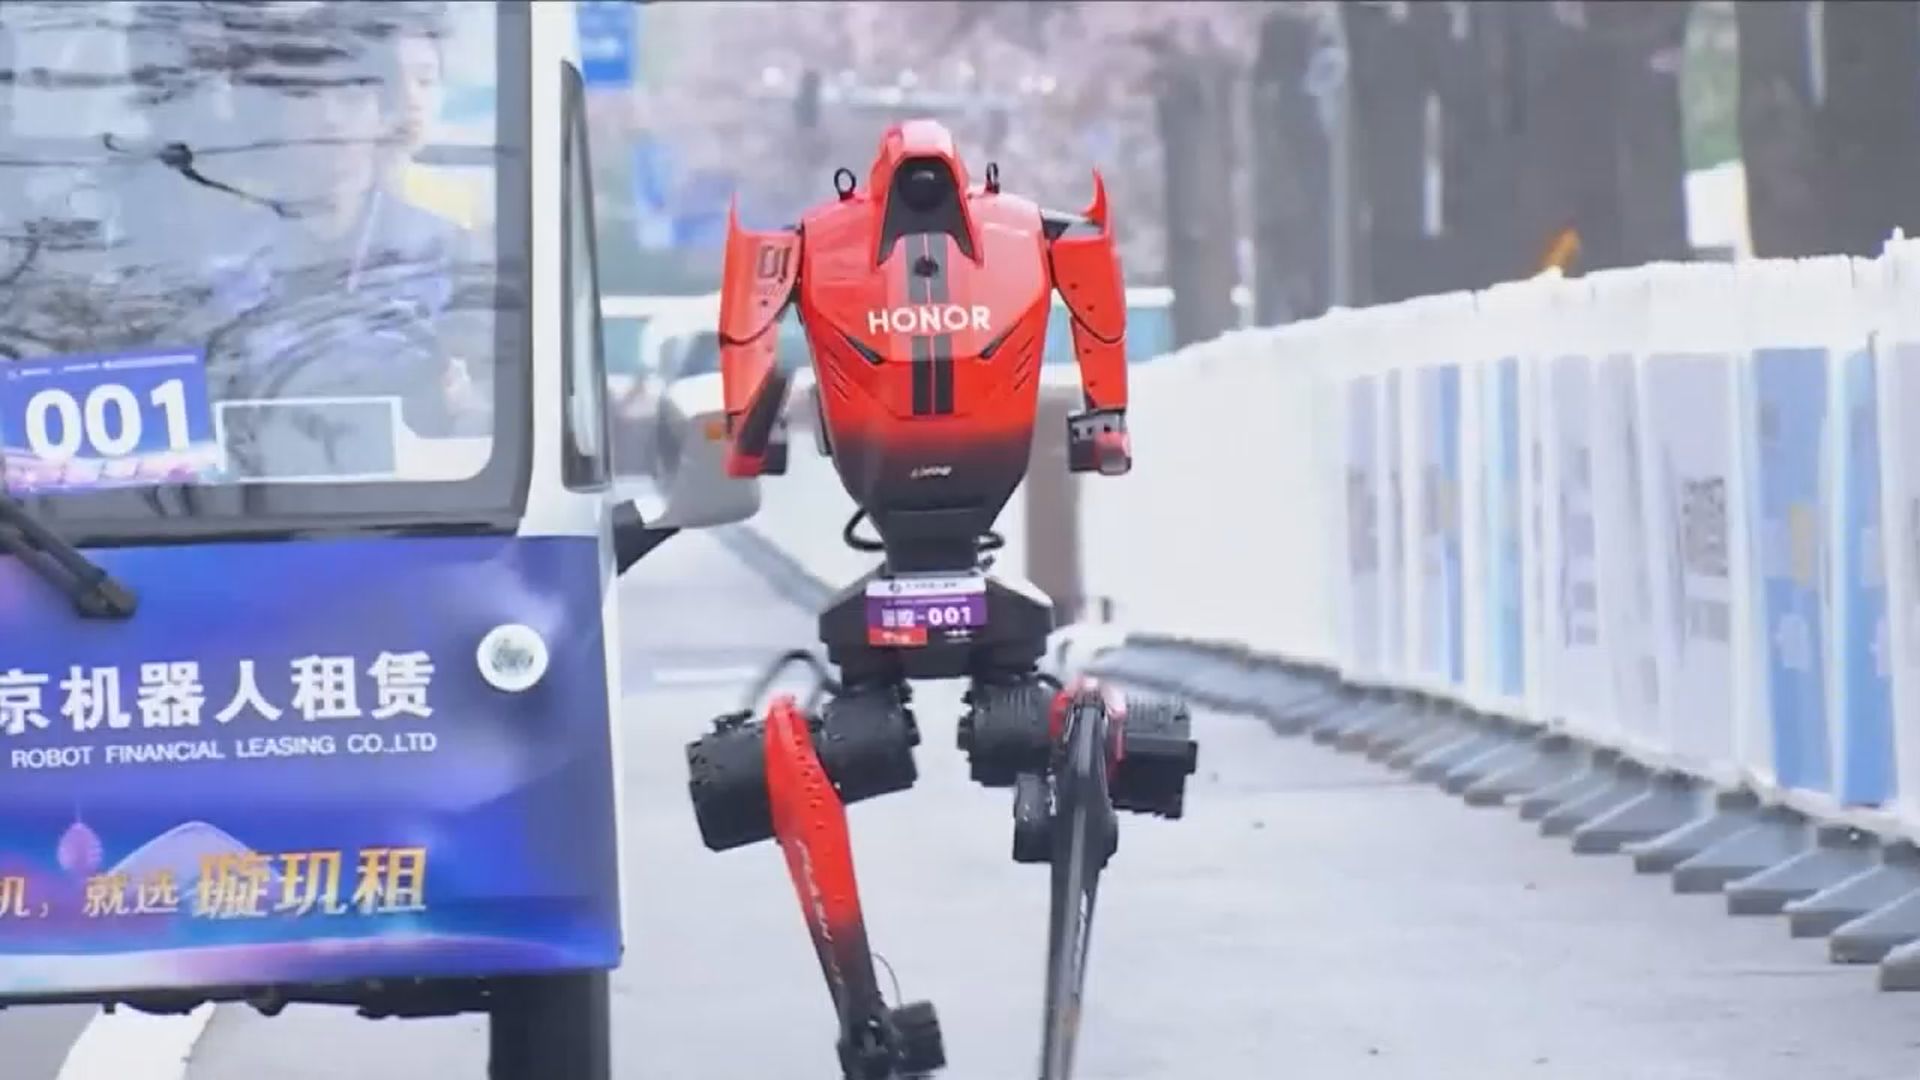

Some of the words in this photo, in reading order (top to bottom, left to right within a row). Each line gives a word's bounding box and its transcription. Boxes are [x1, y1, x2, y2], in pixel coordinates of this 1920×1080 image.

[867, 305, 991, 335] HONOR
[25, 379, 190, 460] 001
[0, 651, 435, 735] 京机器人租赁
[11, 746, 94, 769] ROBOT
[105, 740, 225, 764] FINANCIAL
[235, 735, 336, 759] LEASING
